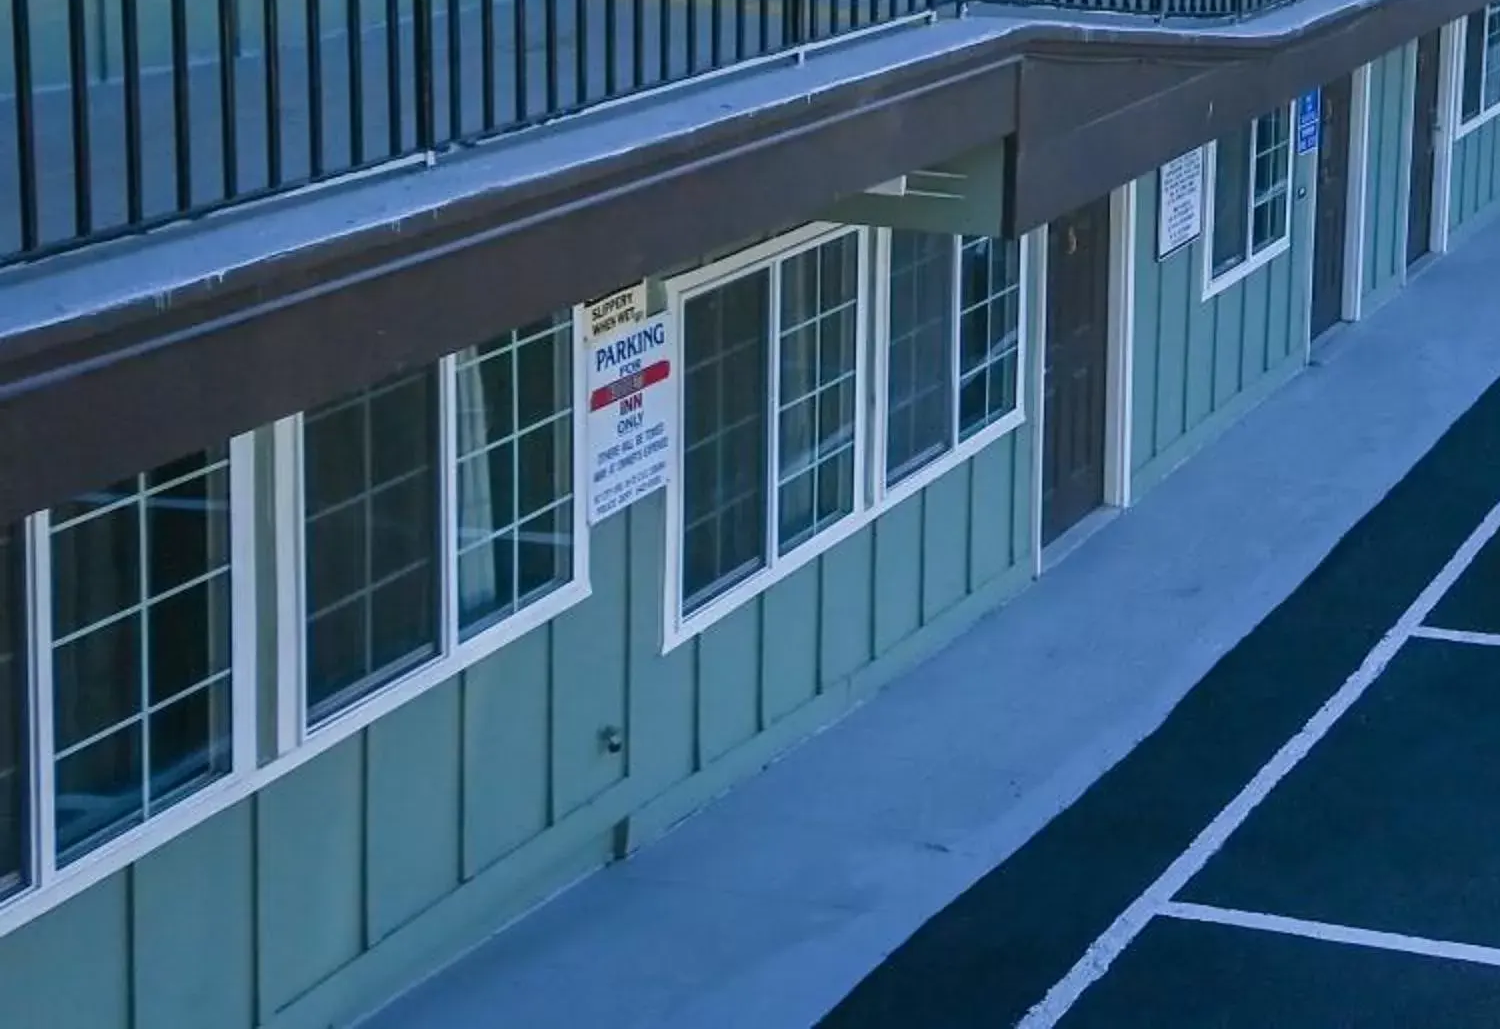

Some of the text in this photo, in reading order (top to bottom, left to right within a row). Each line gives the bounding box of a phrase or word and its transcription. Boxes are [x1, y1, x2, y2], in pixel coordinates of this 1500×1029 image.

[591, 291, 634, 321] SLIPPERY
[592, 305, 636, 337] WHEN WET
[596, 323, 665, 372] PARKING
[619, 358, 642, 377] FOR
[619, 392, 643, 416] INN
[617, 411, 644, 435] ONLY
